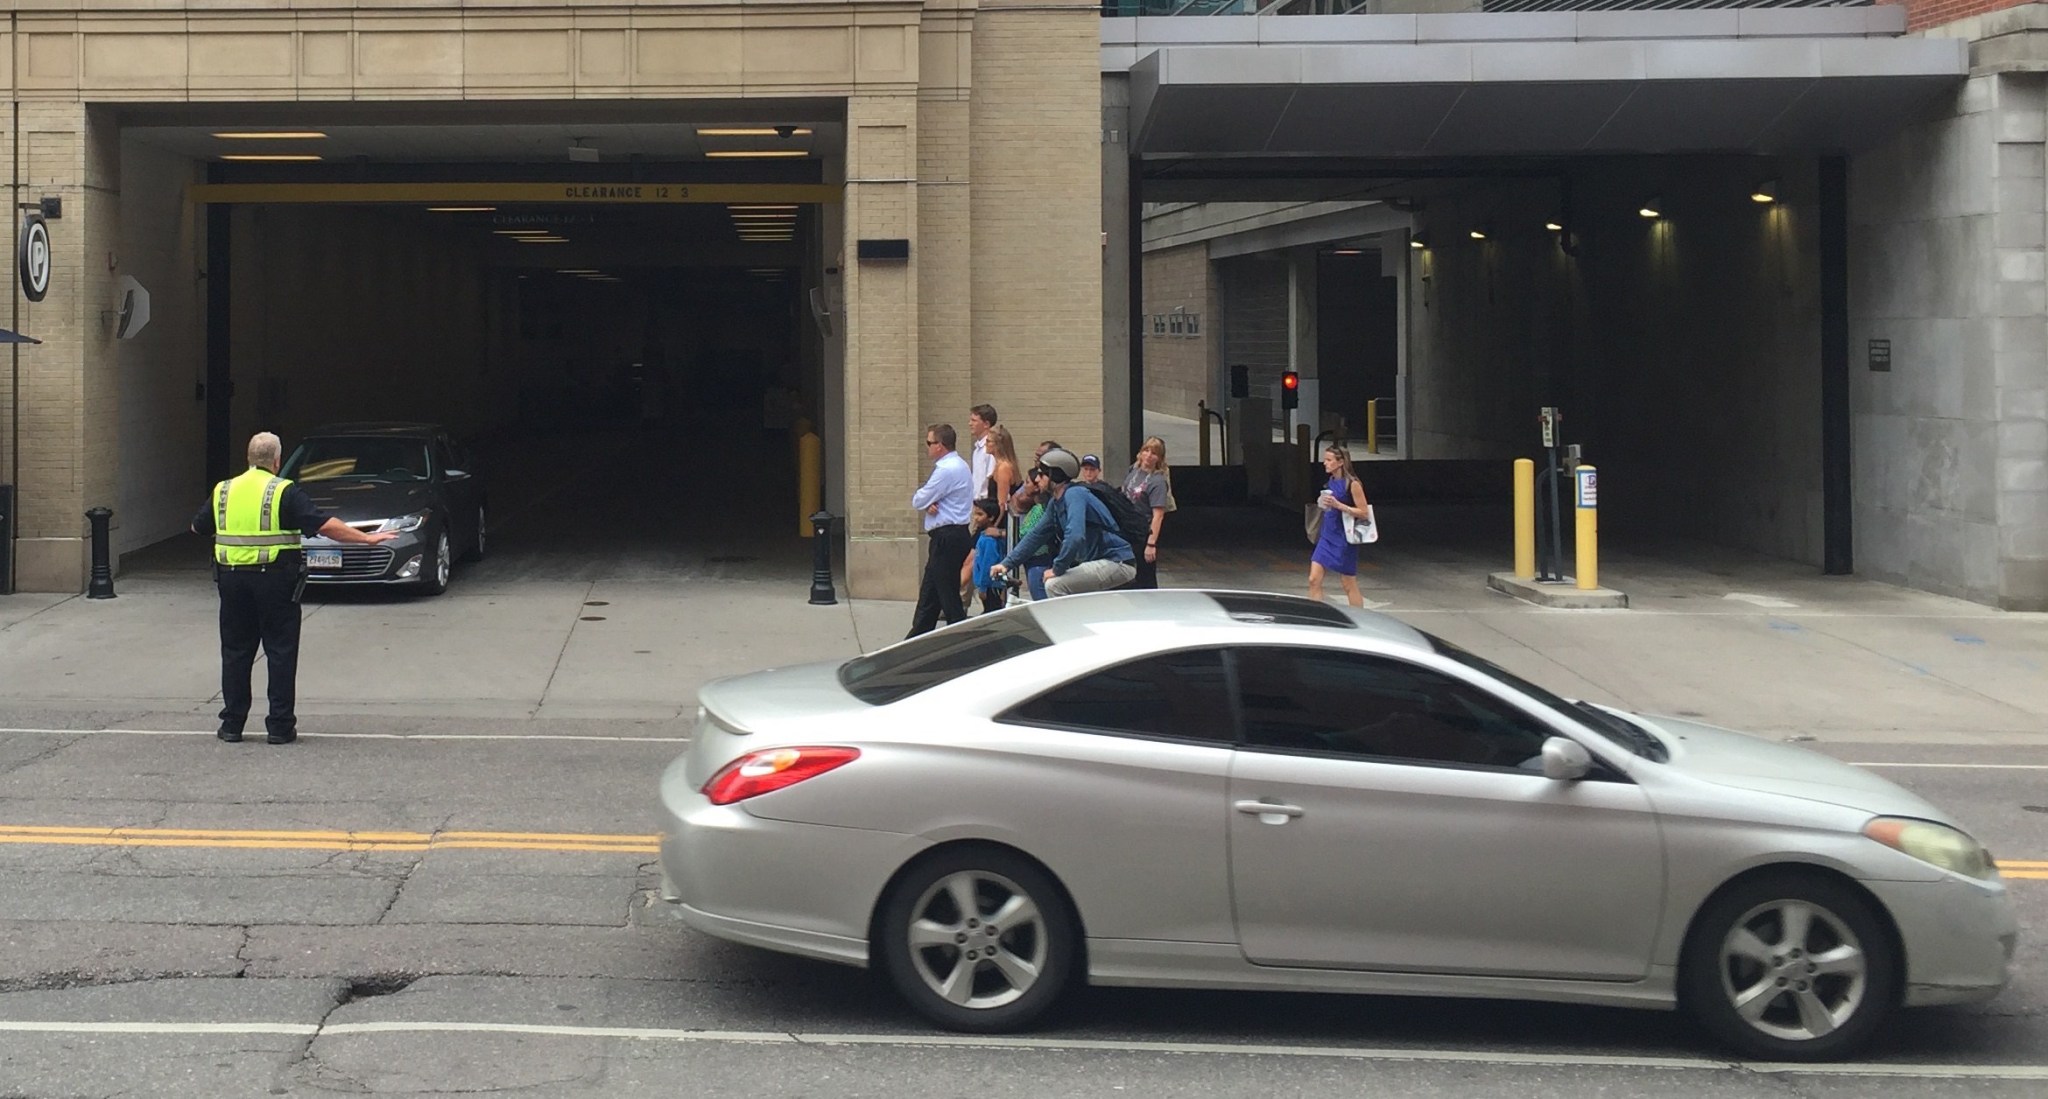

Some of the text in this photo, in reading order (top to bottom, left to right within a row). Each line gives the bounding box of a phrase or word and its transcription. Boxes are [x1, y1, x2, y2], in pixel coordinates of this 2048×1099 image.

[565, 186, 689, 199] CLEARANCE 12 3
[32, 241, 45, 278] P
